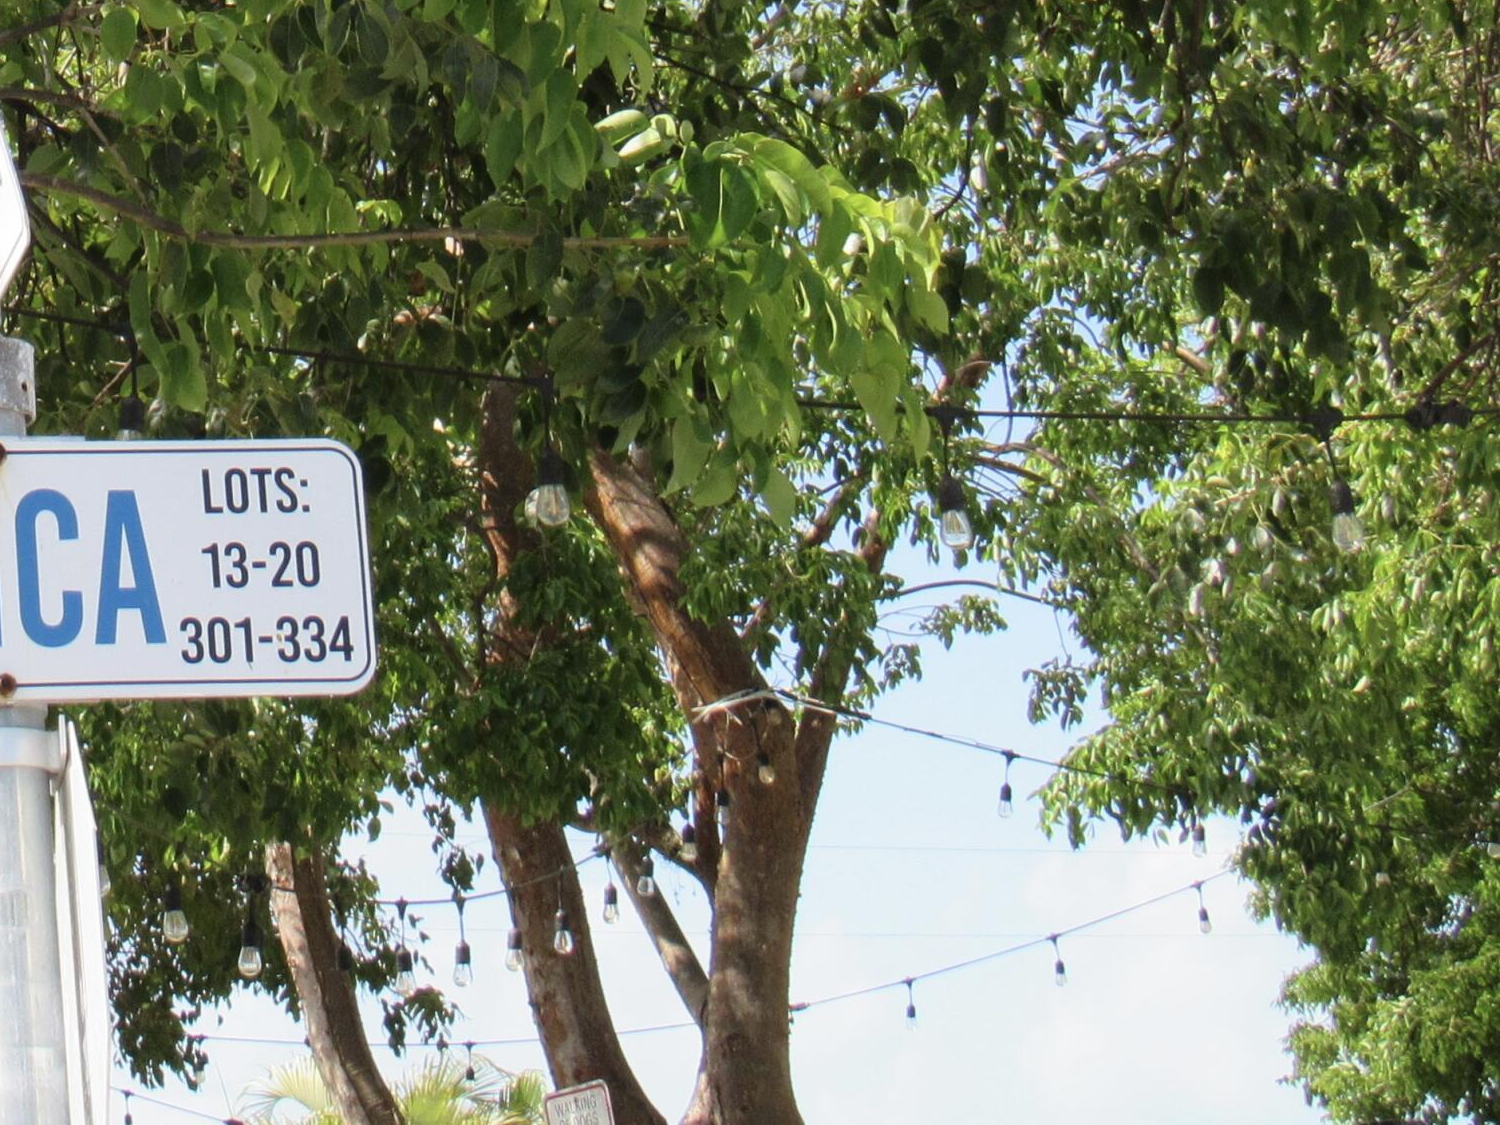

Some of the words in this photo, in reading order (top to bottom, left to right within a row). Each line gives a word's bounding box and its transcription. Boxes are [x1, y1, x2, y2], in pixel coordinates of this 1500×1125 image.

[202, 467, 310, 514] LOTS:
[201, 541, 320, 588] 13-20
[179, 615, 354, 664] 301-334
[554, 1094, 597, 1118] WALKING
